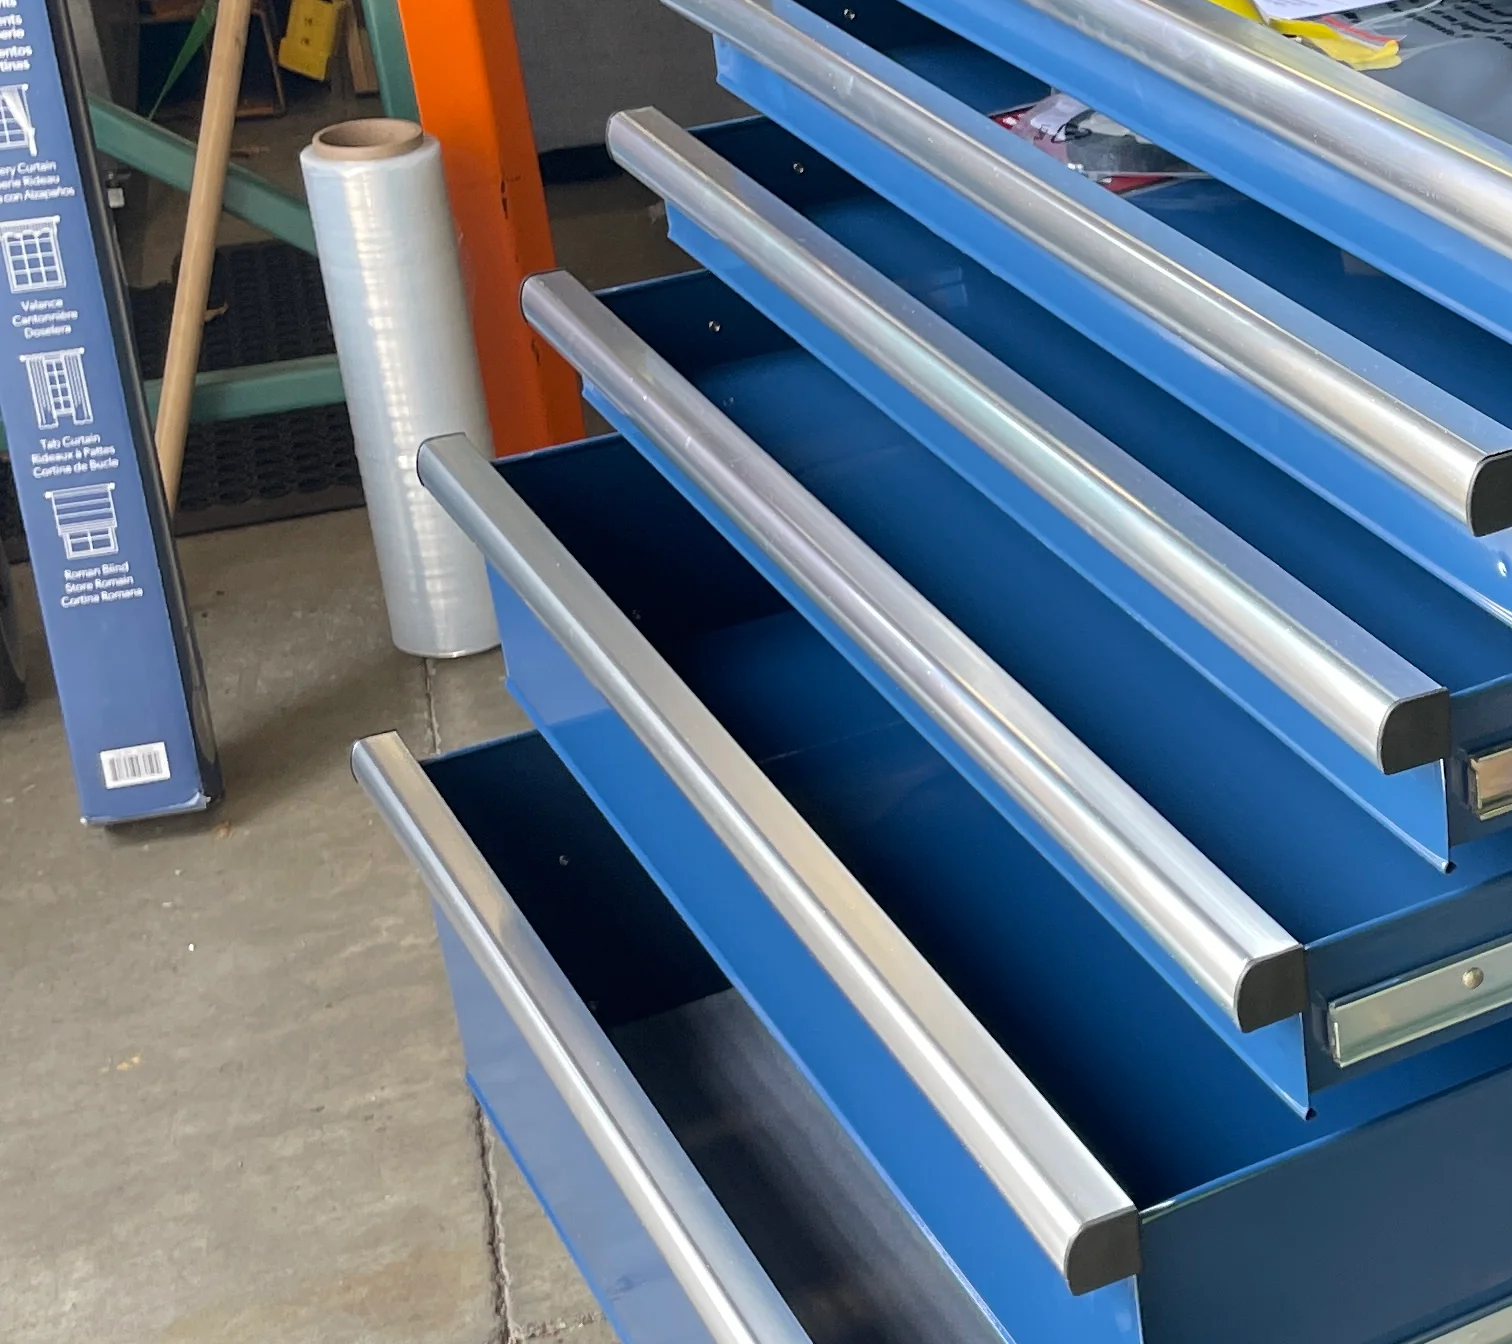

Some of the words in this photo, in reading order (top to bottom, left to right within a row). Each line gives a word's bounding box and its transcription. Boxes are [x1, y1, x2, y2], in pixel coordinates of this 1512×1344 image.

[17, 160, 57, 175] Curtain
[40, 438, 61, 451] Tab
[62, 432, 101, 449] Curtain
[73, 463, 88, 474] de
[64, 567, 101, 581] Roman
[102, 561, 129, 575] Blind
[65, 580, 94, 594] Store
[95, 574, 134, 589] Romain
[61, 593, 100, 609] Cortina
[101, 587, 144, 603] Romana
